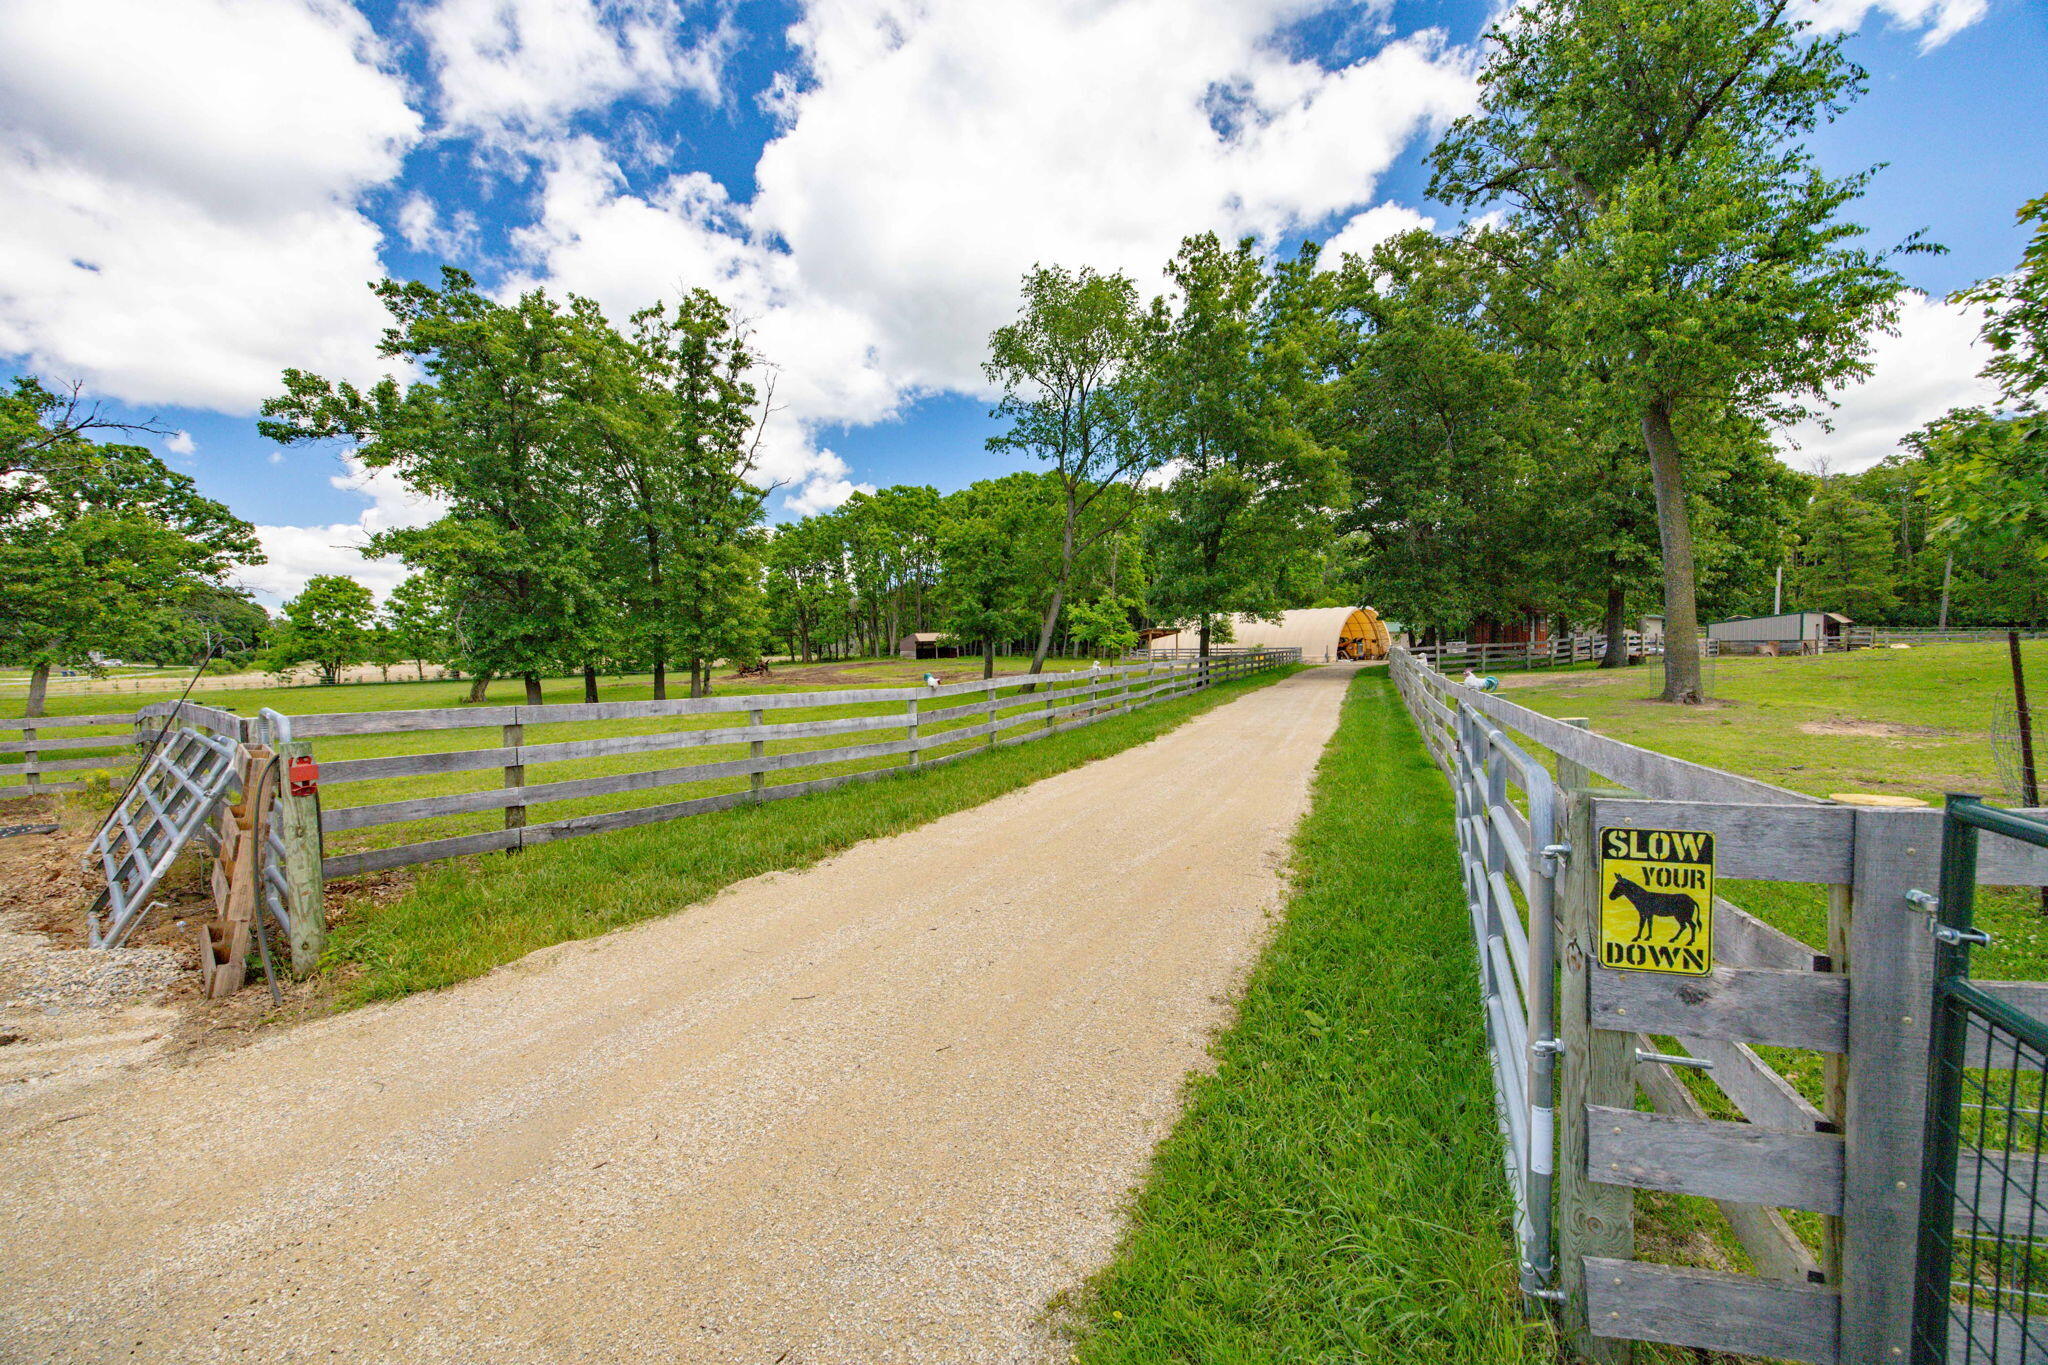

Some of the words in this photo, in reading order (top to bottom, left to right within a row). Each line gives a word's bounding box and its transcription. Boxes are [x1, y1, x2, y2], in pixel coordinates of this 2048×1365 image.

[1607, 830, 1706, 861] SLOW
[1642, 867, 1705, 889] YOUR
[1607, 942, 1703, 970] DOWN
